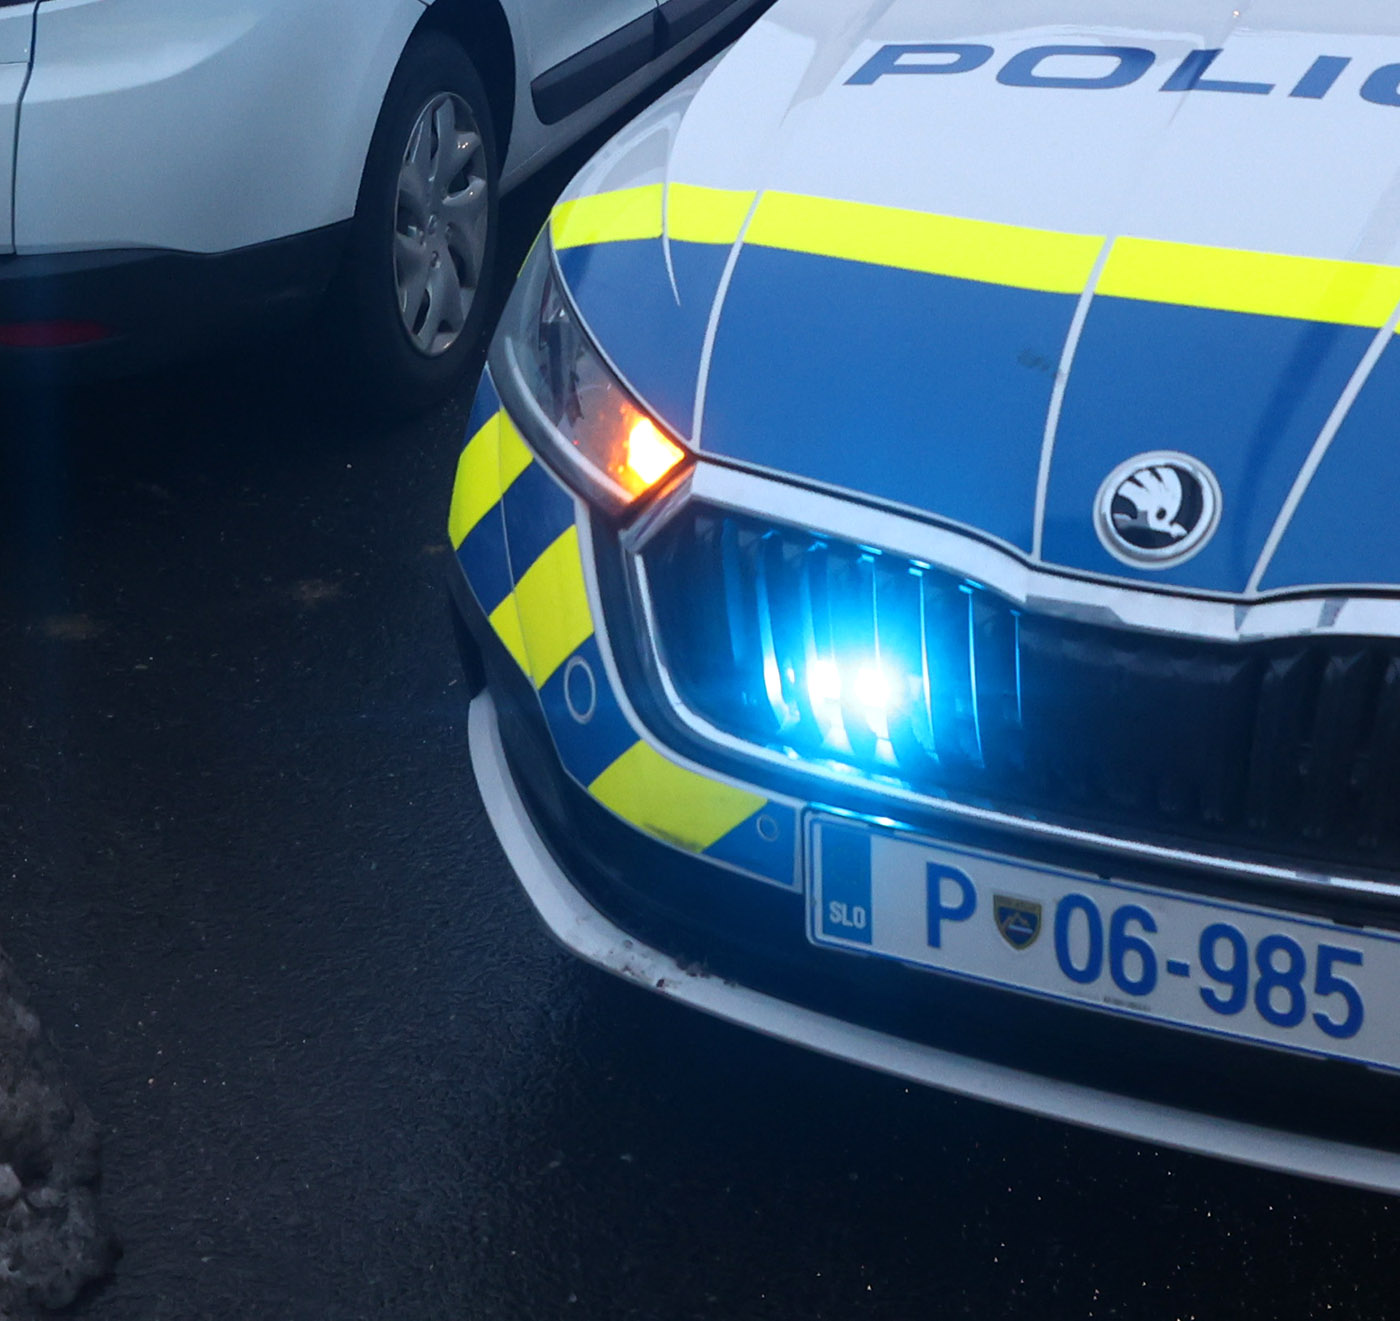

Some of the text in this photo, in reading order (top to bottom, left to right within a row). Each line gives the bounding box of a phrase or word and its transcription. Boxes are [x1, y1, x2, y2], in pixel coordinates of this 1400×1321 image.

[829, 899, 867, 929] SLO
[924, 861, 1365, 1040] P 06-985
